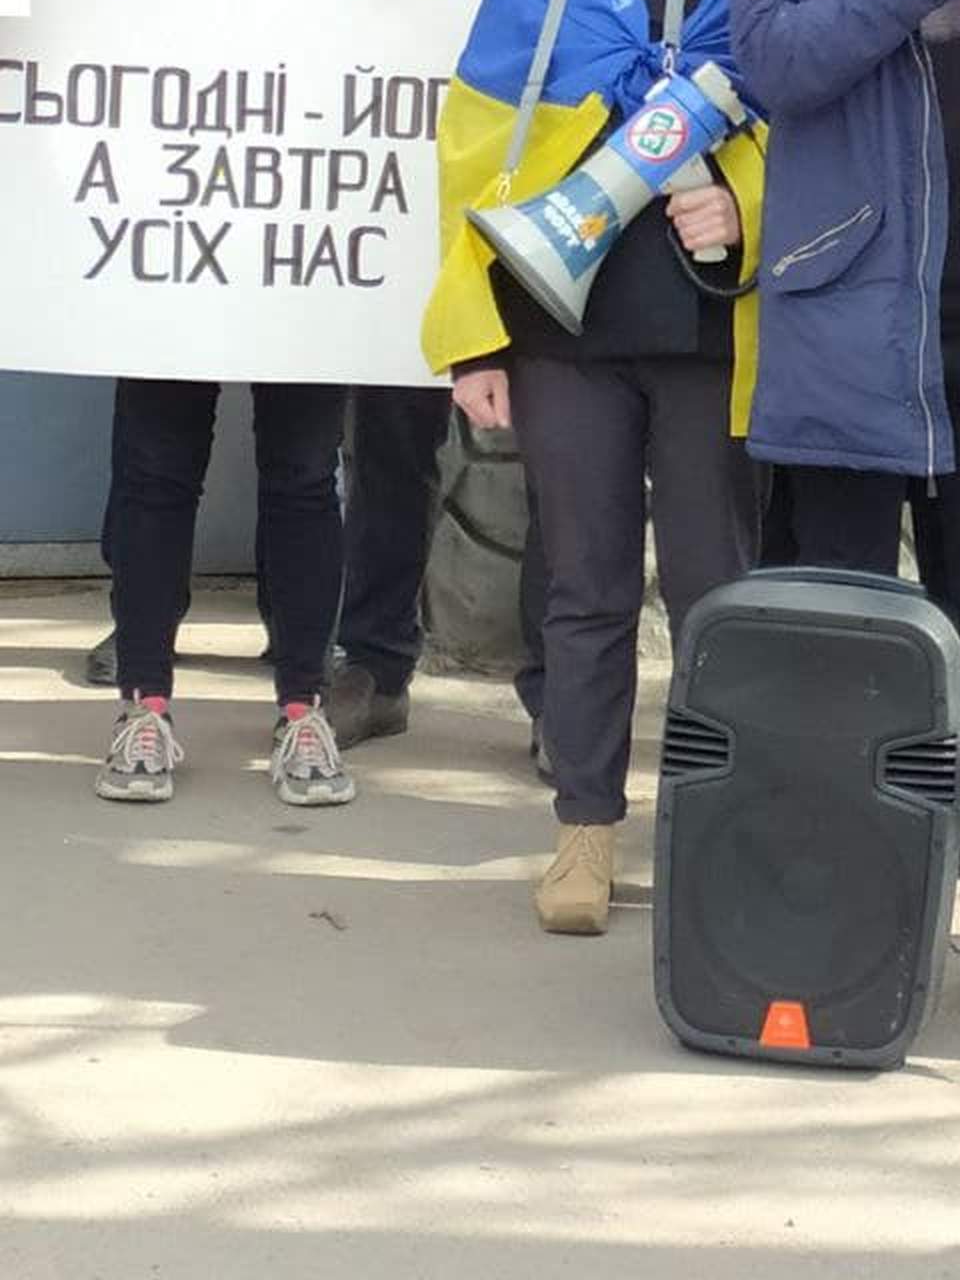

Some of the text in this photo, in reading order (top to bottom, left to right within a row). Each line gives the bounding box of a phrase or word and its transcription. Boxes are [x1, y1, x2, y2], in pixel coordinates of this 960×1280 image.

[74, 140, 409, 214] А ЗАВТРА
[84, 210, 388, 288] УСІХ НАС
